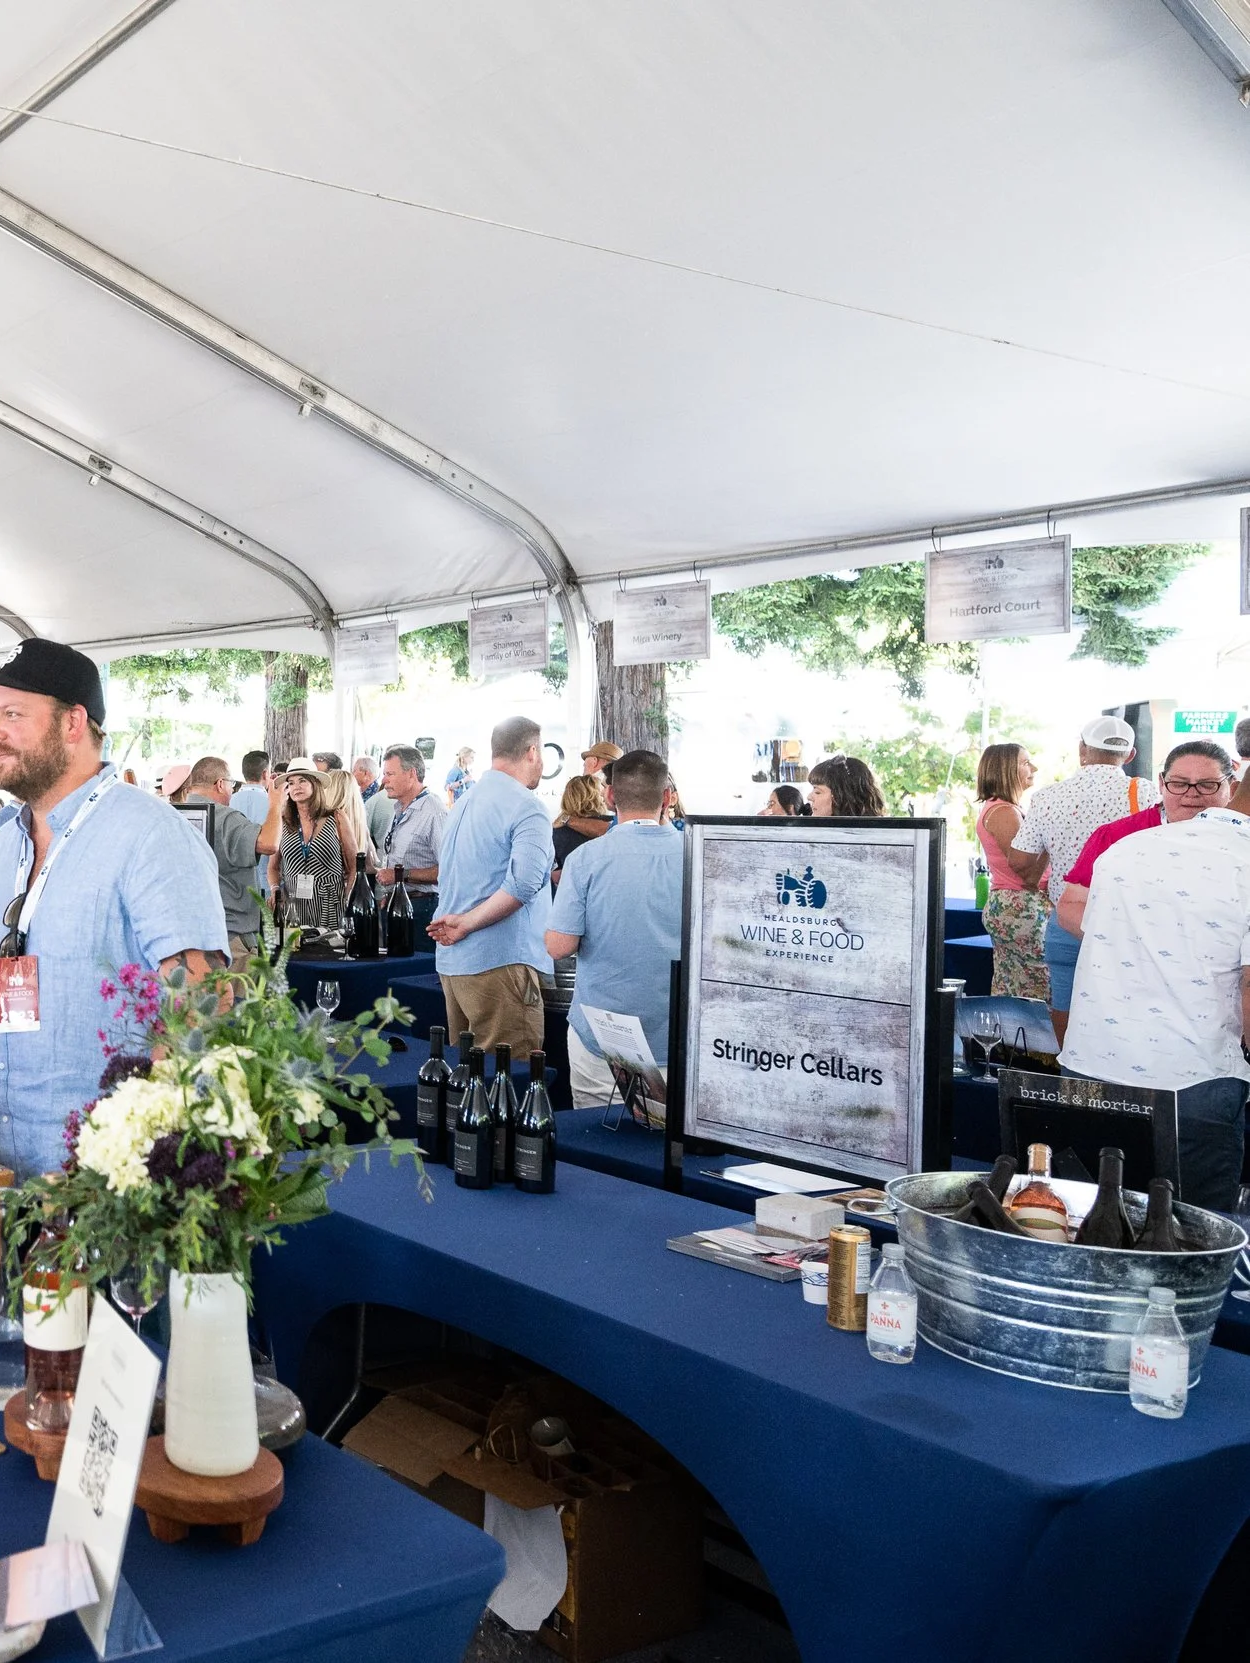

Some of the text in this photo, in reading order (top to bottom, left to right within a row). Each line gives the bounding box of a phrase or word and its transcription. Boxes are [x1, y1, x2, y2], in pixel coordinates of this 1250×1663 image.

[950, 599, 1041, 617] Hartford Court
[651, 632, 682, 642] Winery
[493, 640, 523, 650] Shannon
[1182, 711, 1228, 719] FARMERS
[1186, 718, 1225, 726] MARKET
[1190, 725, 1219, 733] AISLE
[764, 914, 838, 927] HEALDSBURG
[740, 924, 865, 951] WINE & FOOD
[765, 949, 834, 963] EXPERIENCE
[712, 1038, 883, 1086] Stringer Cellars
[1019, 1085, 1154, 1115] brick & mortar
[870, 1312, 901, 1330] PANNA
[1130, 1360, 1157, 1379] ANNA
